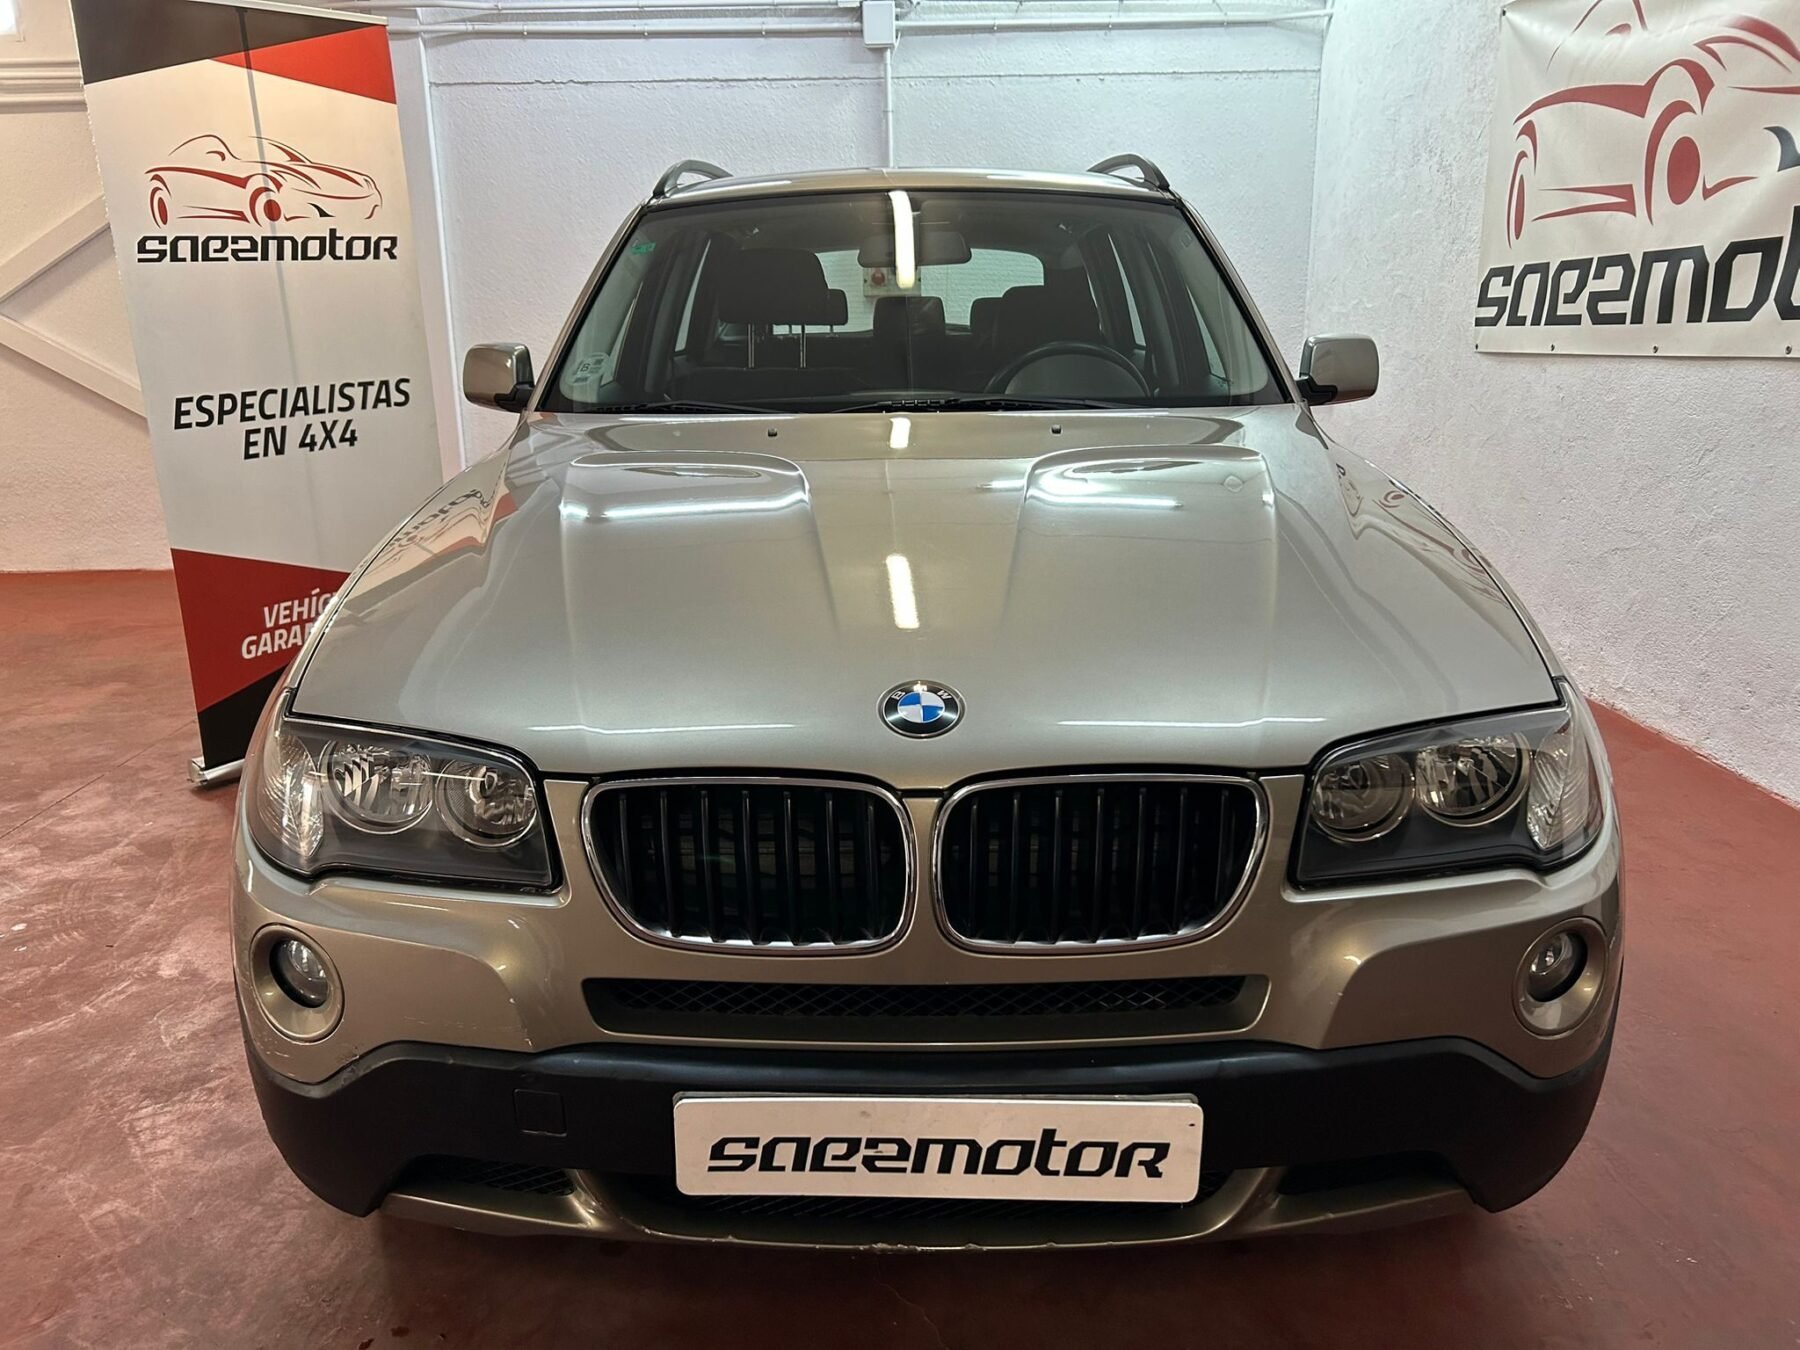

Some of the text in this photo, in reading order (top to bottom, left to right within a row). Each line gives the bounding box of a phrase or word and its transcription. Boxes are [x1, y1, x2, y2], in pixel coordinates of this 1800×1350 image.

[173, 378, 411, 430] ESPECIALISTAS
[243, 419, 358, 460] EN 4X4
[263, 588, 337, 629] VEHÍC
